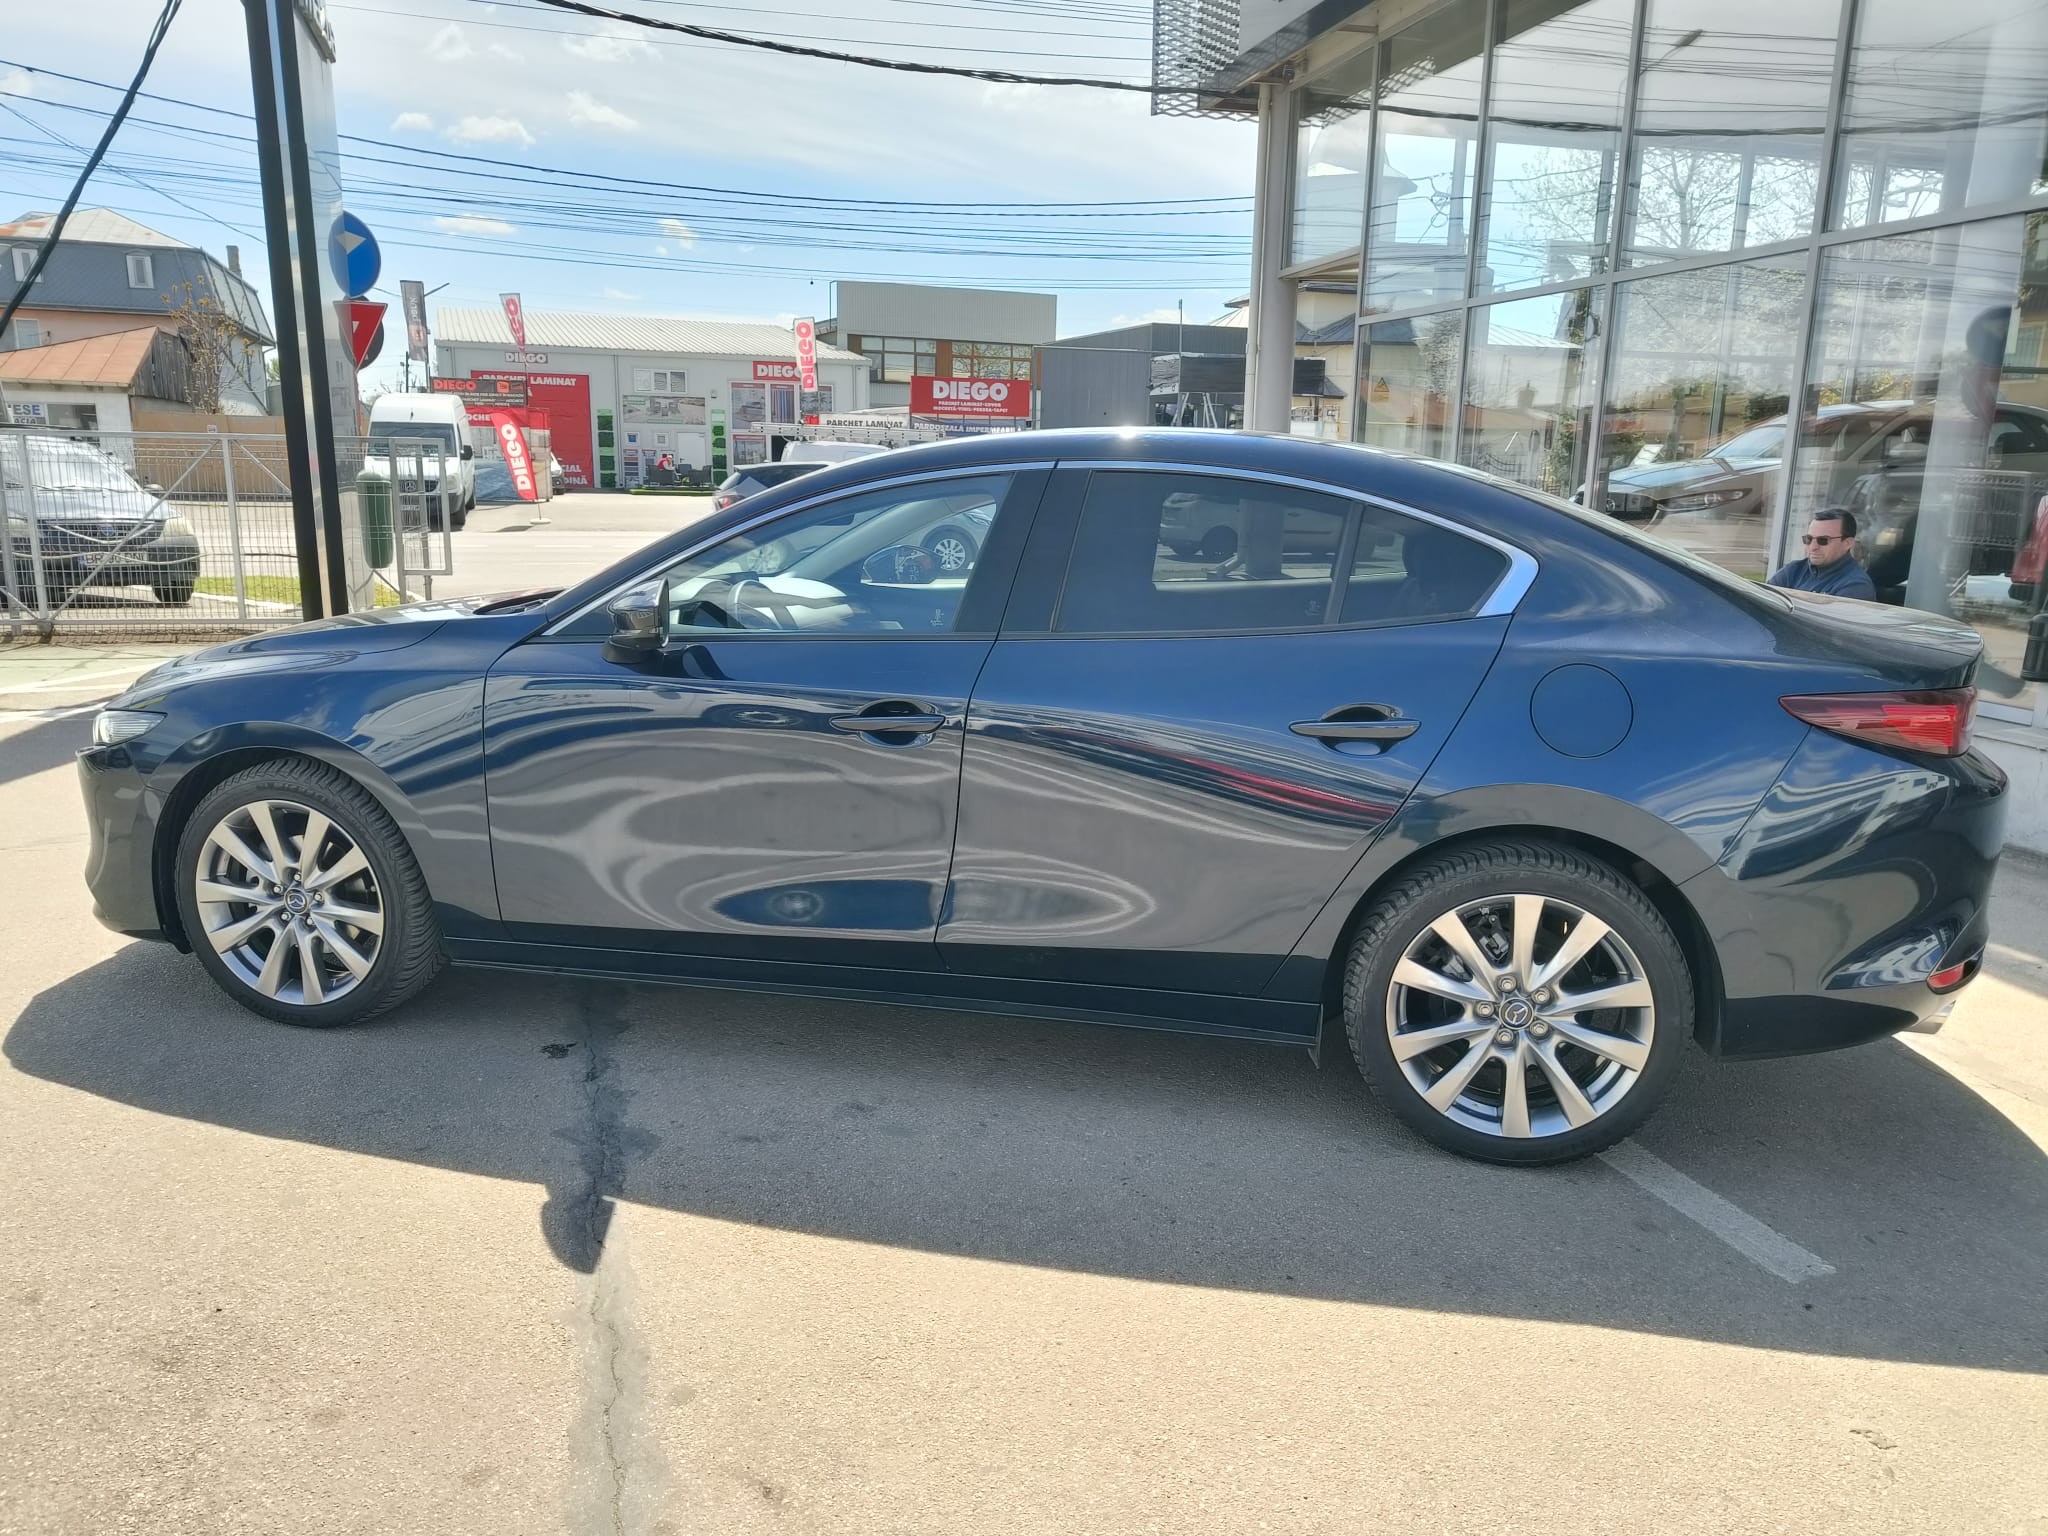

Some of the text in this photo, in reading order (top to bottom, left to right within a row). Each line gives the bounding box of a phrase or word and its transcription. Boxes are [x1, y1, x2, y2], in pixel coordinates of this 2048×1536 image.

[505, 352, 546, 363] DIEGO
[796, 322, 815, 389] DIEGO
[433, 379, 477, 391] DIEGO
[530, 376, 576, 386] LAMINAT
[932, 380, 1008, 401] DIEGO
[466, 413, 491, 421] OCHE
[826, 419, 863, 427] PARCHET
[501, 423, 531, 490] DIEGO
